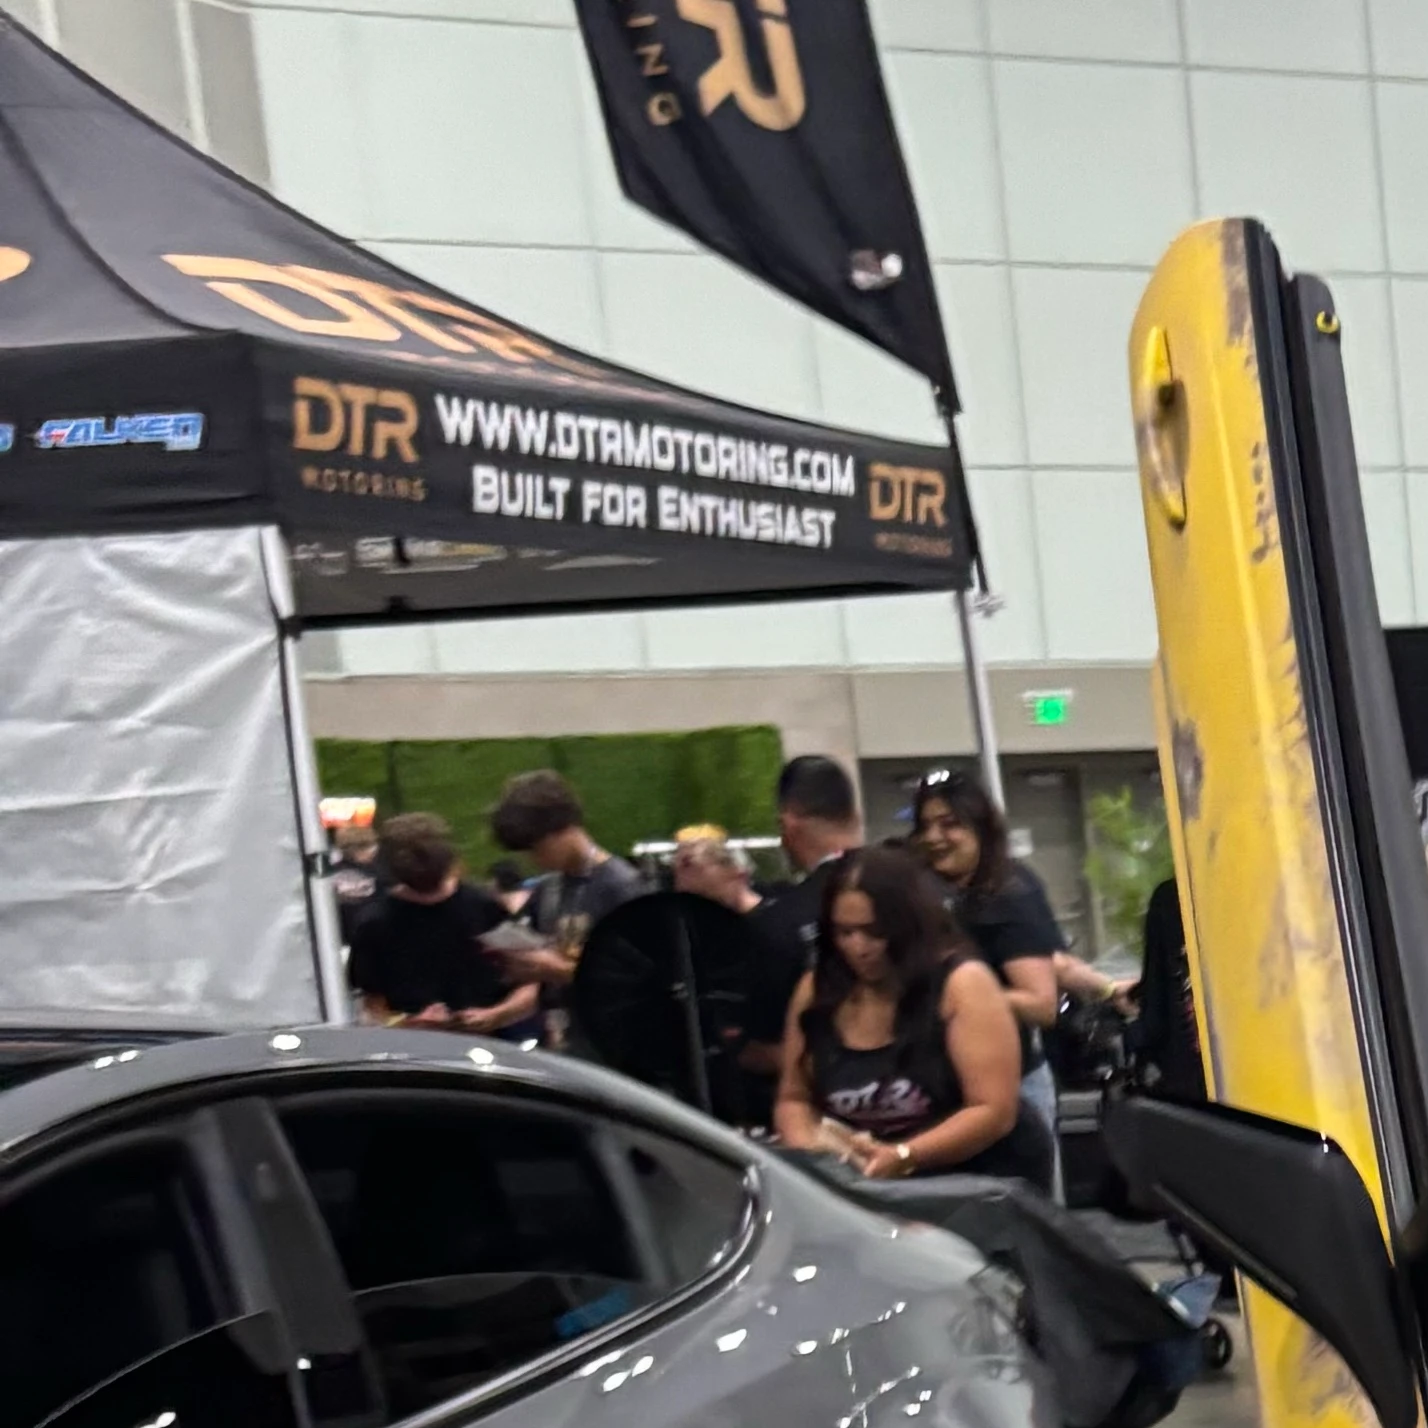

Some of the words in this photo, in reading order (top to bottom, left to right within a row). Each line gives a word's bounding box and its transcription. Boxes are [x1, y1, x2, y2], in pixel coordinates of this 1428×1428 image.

[293, 376, 420, 463] DTR
[433, 393, 856, 497] WWW.DTRMOTORING.COM
[471, 464, 572, 521] BUILT
[581, 479, 647, 529] FOR
[657, 485, 836, 549] ENTHUSIAST
[868, 462, 949, 528] DTR
